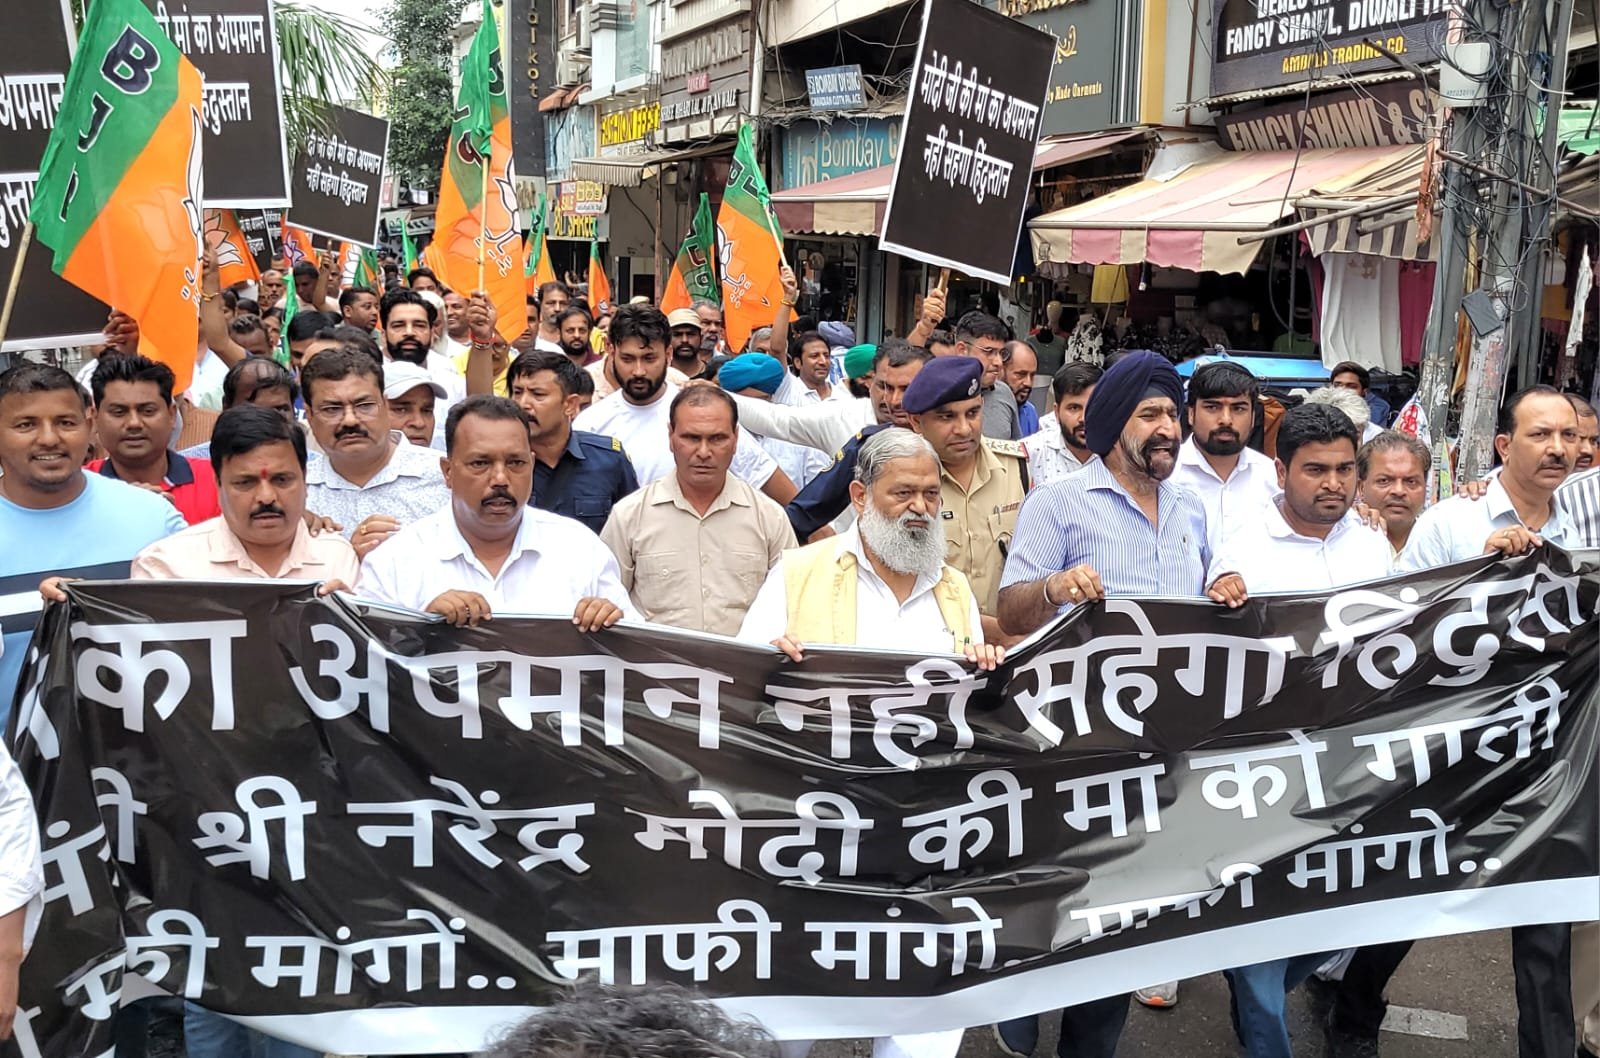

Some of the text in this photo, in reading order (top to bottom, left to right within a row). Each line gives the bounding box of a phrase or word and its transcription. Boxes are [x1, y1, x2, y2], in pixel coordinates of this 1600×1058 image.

[171, 3, 191, 54] मां
[191, 15, 213, 54] का
[217, 14, 265, 54] अपमान
[1226, 20, 1274, 55] FANCY
[1387, 36, 1407, 54] CO.
[921, 50, 1040, 142] मोदी जी की मां का अपमान
[821, 129, 884, 169] Bombay
[1226, 114, 1298, 151] FANCY
[1298, 98, 1390, 149] SHAWL
[1388, 102, 1414, 145] &
[320, 165, 340, 197] सहेगा
[339, 170, 369, 207] हिंदुस्तान
[357, 149, 382, 176] अपमान
[924, 123, 949, 181] नहीं
[944, 128, 973, 188] सहेगा
[969, 137, 1014, 204] हिंदुस्तान
[71, 619, 247, 732] का
[289, 623, 734, 750] अपमान
[1014, 599, 1296, 752] सहेगा
[192, 775, 317, 881] श्री
[347, 774, 596, 874] नरेंद्र
[624, 789, 875, 886] मोदी
[902, 769, 1034, 871] की
[1055, 751, 1166, 838] मां
[1188, 729, 1328, 819] को
[1352, 676, 1570, 788] गाली
[545, 898, 782, 986] माफी
